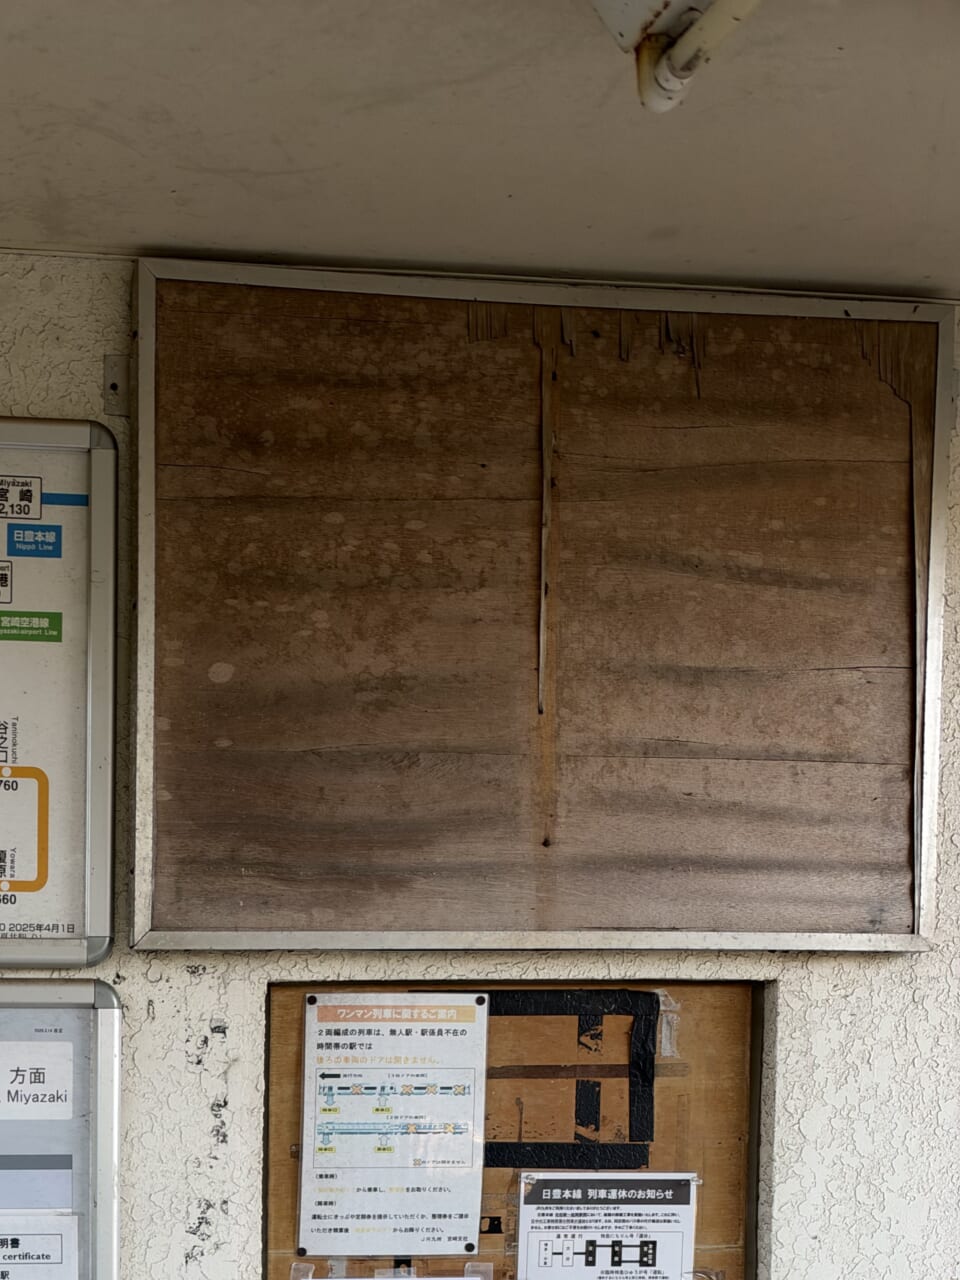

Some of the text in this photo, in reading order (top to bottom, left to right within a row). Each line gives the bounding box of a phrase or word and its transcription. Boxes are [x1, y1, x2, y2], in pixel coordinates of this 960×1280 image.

[14, 530, 56, 542] 日豊本線
[1, 617, 49, 628] 宮崎空港線
[8, 923, 75, 934] 2025年4月1日
[337, 1008, 457, 1020] ワンマン列車に関するご案内
[316, 1042, 373, 1050] 時間帯の駅では
[9, 1067, 46, 1085] 方面
[7, 1089, 68, 1107] Miyazaki
[542, 1188, 674, 1201] 日豊本線 列車運休のお知らせ
[2, 1251, 51, 1261] certificate
